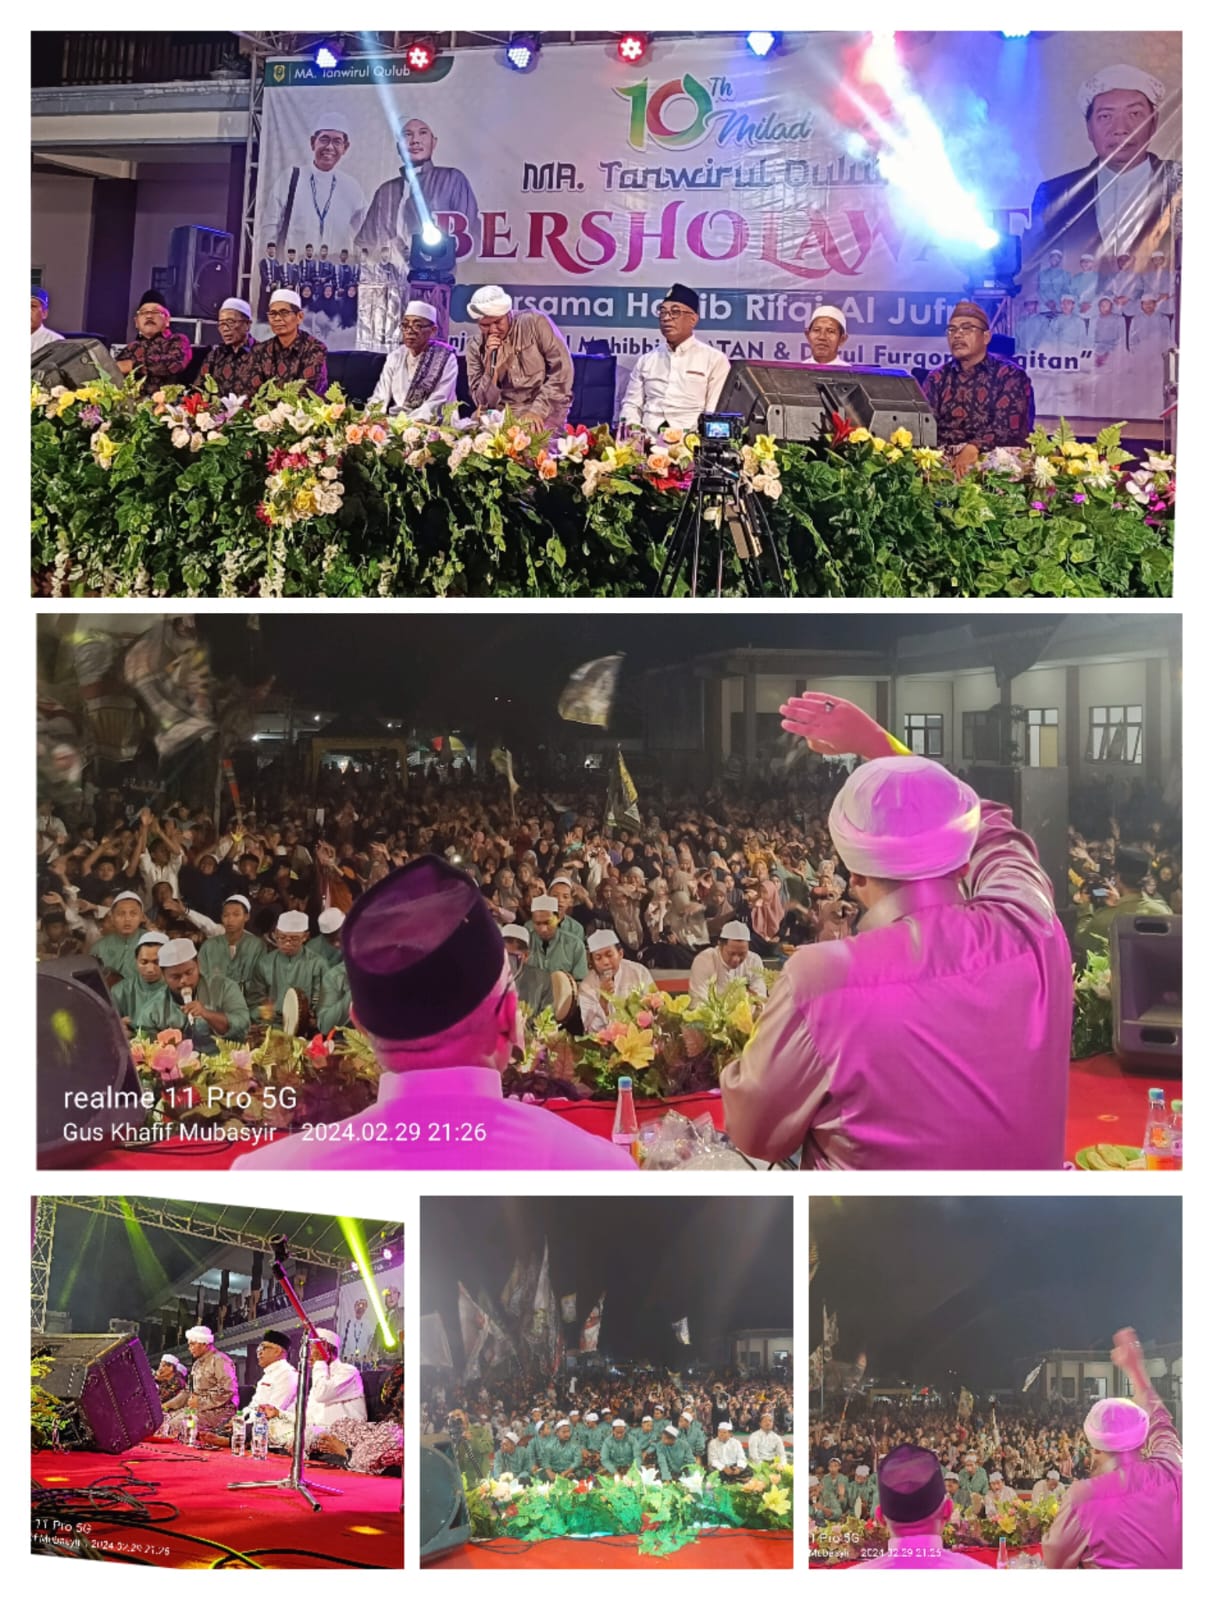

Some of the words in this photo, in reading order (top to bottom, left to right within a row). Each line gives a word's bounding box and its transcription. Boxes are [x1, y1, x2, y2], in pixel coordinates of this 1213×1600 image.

[294, 67, 317, 79] MA.
[373, 64, 411, 77] Qulub
[704, 109, 812, 144] Milad
[523, 162, 585, 191] MA.
[600, 158, 769, 190] Tanwirul
[434, 200, 1030, 279] BERSHOLAW
[627, 292, 732, 320] Haib
[842, 296, 875, 324] Al
[774, 341, 790, 361] &
